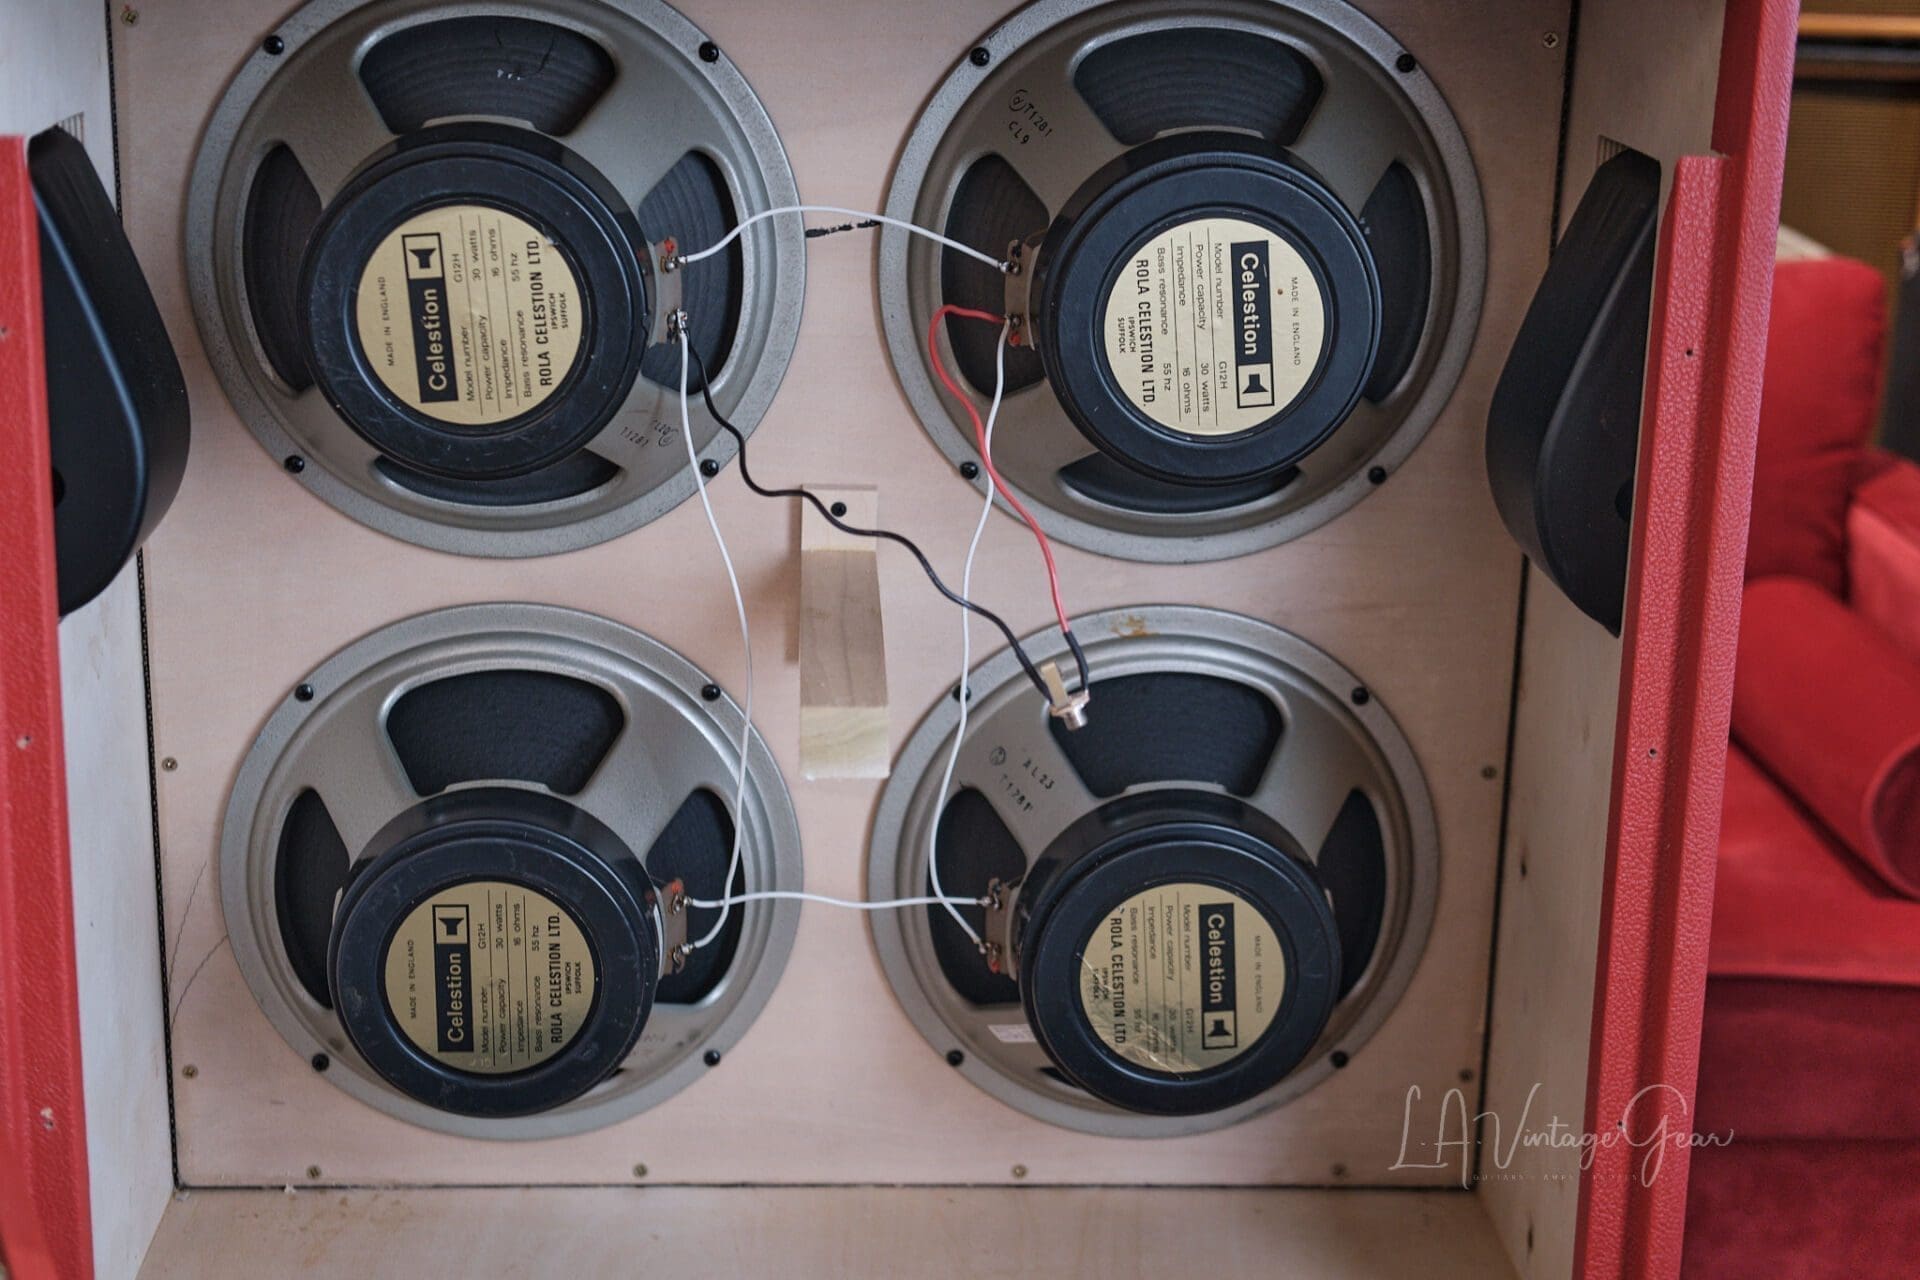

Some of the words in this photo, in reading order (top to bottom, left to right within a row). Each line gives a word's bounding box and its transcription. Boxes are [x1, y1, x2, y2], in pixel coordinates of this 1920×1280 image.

[1009, 121, 1029, 144] CL9
[469, 230, 479, 261] watts
[488, 229, 498, 261] ohms
[510, 253, 518, 266] hz
[527, 237, 540, 264] LTD.
[1158, 248, 1166, 273] Bass
[1215, 243, 1224, 273] Model
[452, 253, 462, 282] G12H
[472, 269, 481, 280] 30
[491, 268, 499, 276] 16
[512, 269, 520, 281] 55
[1177, 246, 1187, 305] Impedance
[1196, 244, 1205, 278] Power
[1136, 260, 1150, 294] ROLA
[1291, 277, 1299, 302] MADE
[378, 277, 388, 320] ENGLAND
[530, 272, 548, 344] CELESTION
[549, 293, 557, 329] IPSWICH
[559, 292, 568, 328] SUFFOLK
[1159, 279, 1169, 335] resonance
[1197, 284, 1206, 329] capacity
[1216, 278, 1224, 318] number
[1241, 253, 1259, 355] Celestion
[1293, 308, 1299, 316] IN
[384, 327, 390, 335] IN
[422, 288, 447, 391] Celestion
[478, 315, 491, 360] capacity
[516, 310, 529, 366] resonance
[1128, 317, 1136, 352] IPSWICH
[1138, 302, 1153, 373] CELESTION
[386, 342, 395, 366] MADE
[461, 327, 471, 367] number
[482, 367, 494, 399] Power
[499, 340, 512, 399] Impedance
[538, 352, 552, 385] ROLA
[1164, 363, 1171, 375] 55
[1182, 368, 1190, 376] 16
[1201, 363, 1209, 375] 30
[1219, 361, 1227, 389] G12H
[465, 370, 475, 401] Model
[522, 372, 532, 397] Bass
[1142, 380, 1155, 406] LTD.
[1164, 378, 1172, 391] hz
[1183, 383, 1192, 414] ohms
[1202, 381, 1210, 412] watts
[495, 904, 503, 932] watts
[532, 925, 539, 937] hz
[548, 912, 560, 937] LTD.
[1110, 918, 1123, 948] ROLA
[478, 924, 486, 949] G12H
[496, 938, 504, 949] 30
[532, 940, 539, 951] 55
[407, 940, 415, 979] ENGLAND
[1208, 914, 1225, 1003] Celestion
[549, 943, 561, 1006] CELESTION
[574, 962, 582, 994] SUFFOLK
[1111, 955, 1124, 1017] CELESTION
[446, 953, 465, 1042] Celestion
[480, 986, 488, 1023] number
[497, 979, 506, 1018] capacity
[533, 976, 541, 1025] resonance
[480, 1027, 489, 1053] Model
[499, 1024, 507, 1053] Power
[515, 1000, 524, 1052] Impedance
[534, 1030, 543, 1052] Bass
[550, 1013, 562, 1043] ROLA
